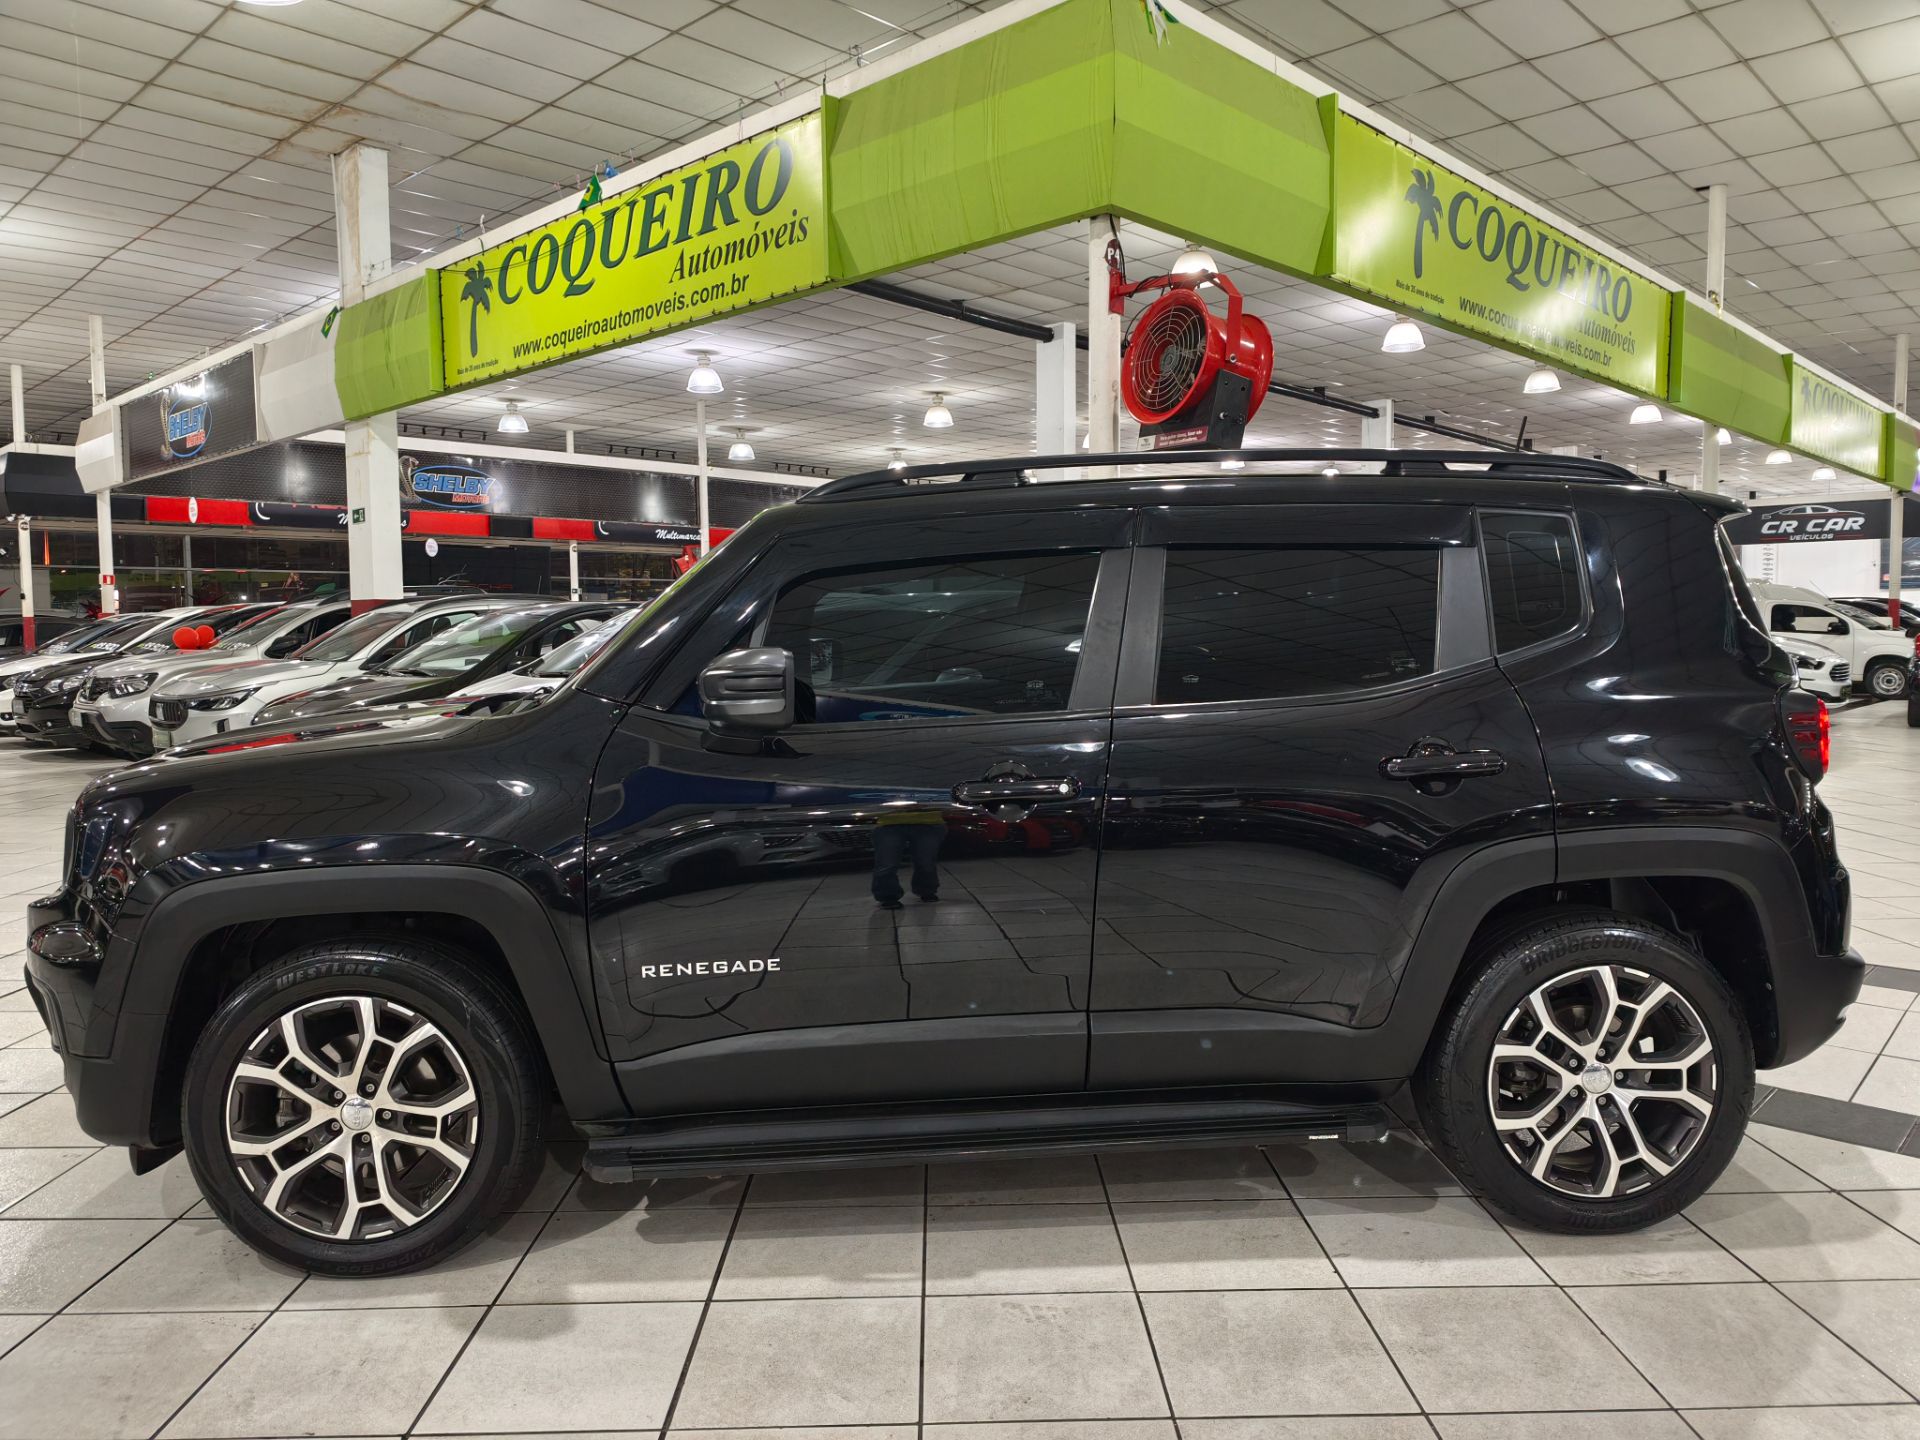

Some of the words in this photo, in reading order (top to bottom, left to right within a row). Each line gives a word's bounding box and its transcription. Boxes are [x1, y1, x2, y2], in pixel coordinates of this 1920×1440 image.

[499, 138, 794, 305] COQUEIRO
[668, 209, 810, 284] Automóveis
[1448, 190, 1633, 323] COQUEIRO
[512, 272, 750, 360] www.coqueiroautomoveis.com.br
[169, 401, 208, 442] SHELBY
[412, 472, 496, 495] SHELBY
[655, 528, 702, 541] Multimarca
[1760, 520, 1798, 534] CR
[1805, 517, 1866, 532] CAR
[275, 962, 384, 991] WESTLAKE
[641, 957, 781, 978] RENEGADE
